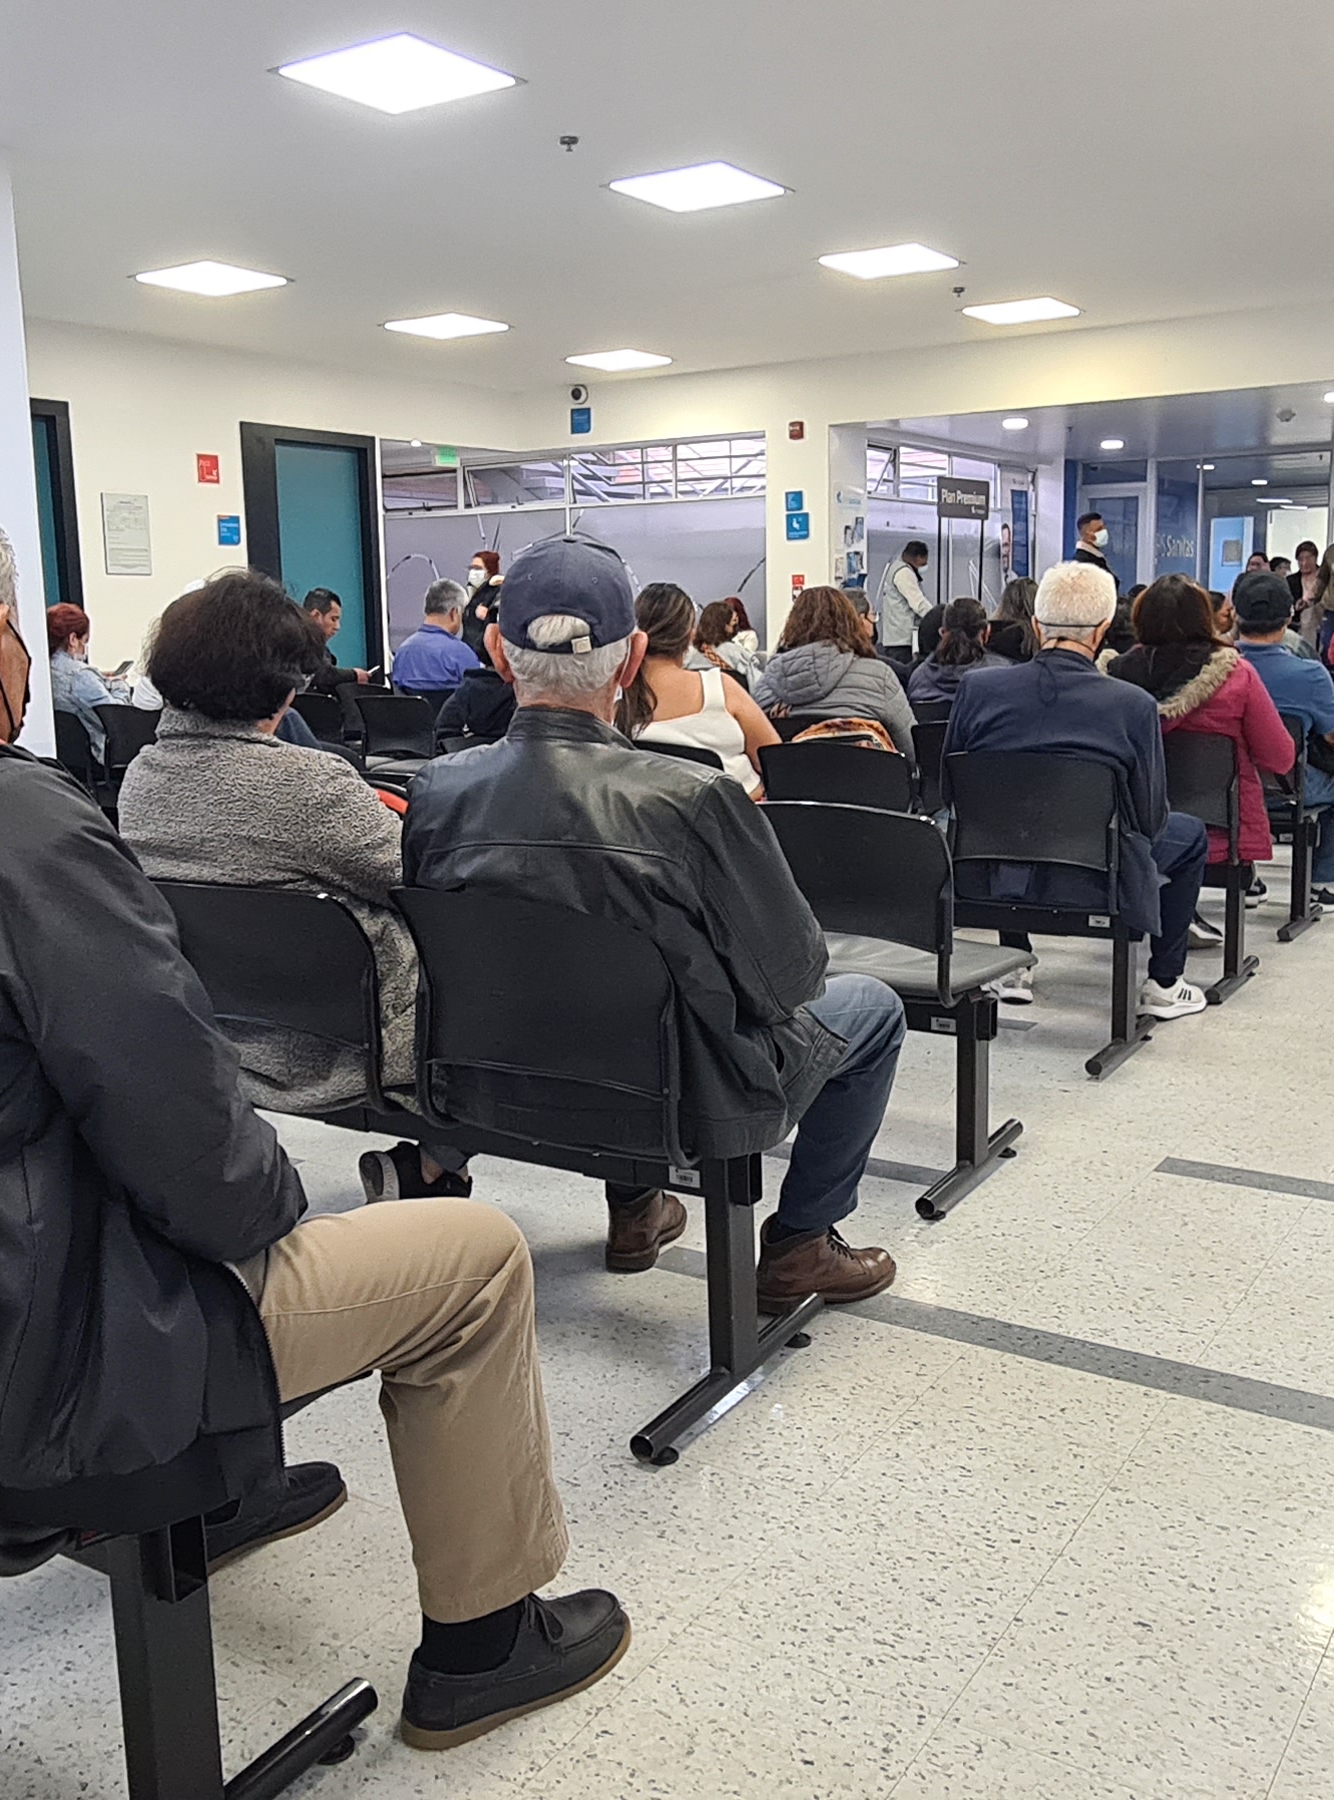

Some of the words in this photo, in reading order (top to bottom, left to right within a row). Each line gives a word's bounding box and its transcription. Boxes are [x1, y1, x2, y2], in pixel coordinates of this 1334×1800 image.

[941, 488, 956, 504] Plan
[957, 490, 986, 505] Premium
[1167, 535, 1194, 556] Sanitas
